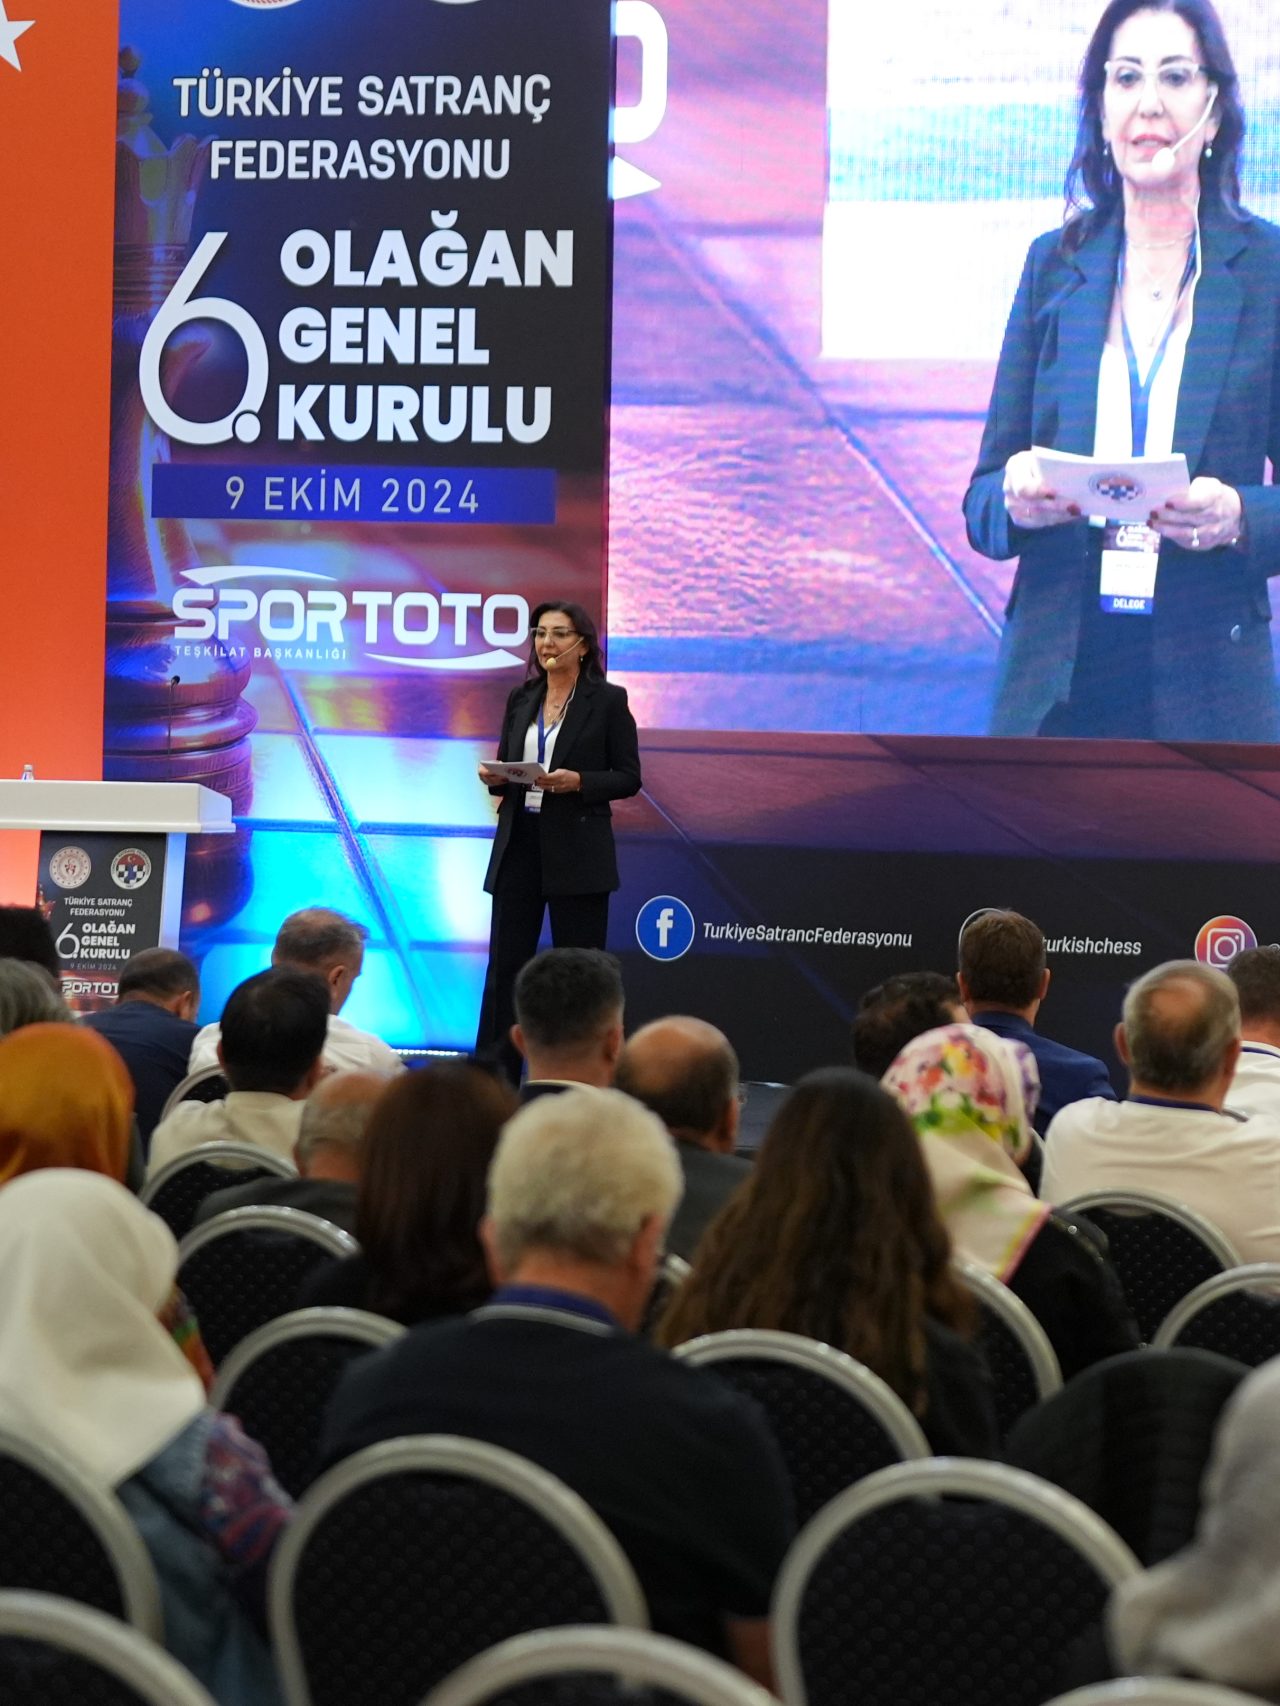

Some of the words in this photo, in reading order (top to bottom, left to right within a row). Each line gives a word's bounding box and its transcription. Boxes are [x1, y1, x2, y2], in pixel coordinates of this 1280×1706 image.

[173, 67, 343, 117] TÜRKİYE
[358, 74, 551, 123] SATRANÇ
[210, 138, 510, 180] FEDERASYONU
[280, 209, 574, 287] OLAĞAN
[139, 231, 269, 445] 6.
[279, 307, 489, 365] GENEL
[278, 384, 551, 443] KURULU
[225, 475, 245, 510] 9
[264, 469, 361, 512] EKİM
[381, 478, 479, 514] 2024
[175, 645, 246, 658] TEŞKİLAT
[254, 647, 346, 660] BAŞKANLIĞI
[64, 896, 95, 905] TÜRKİYE
[97, 898, 133, 908] SATRANÇ
[70, 907, 126, 917] FEDERASYONU
[81, 935, 120, 947] GENEL
[82, 920, 136, 934] OLAĞAN
[703, 922, 912, 949] TurkiyeSatrancFederasyonu
[80, 948, 131, 960] KURULU
